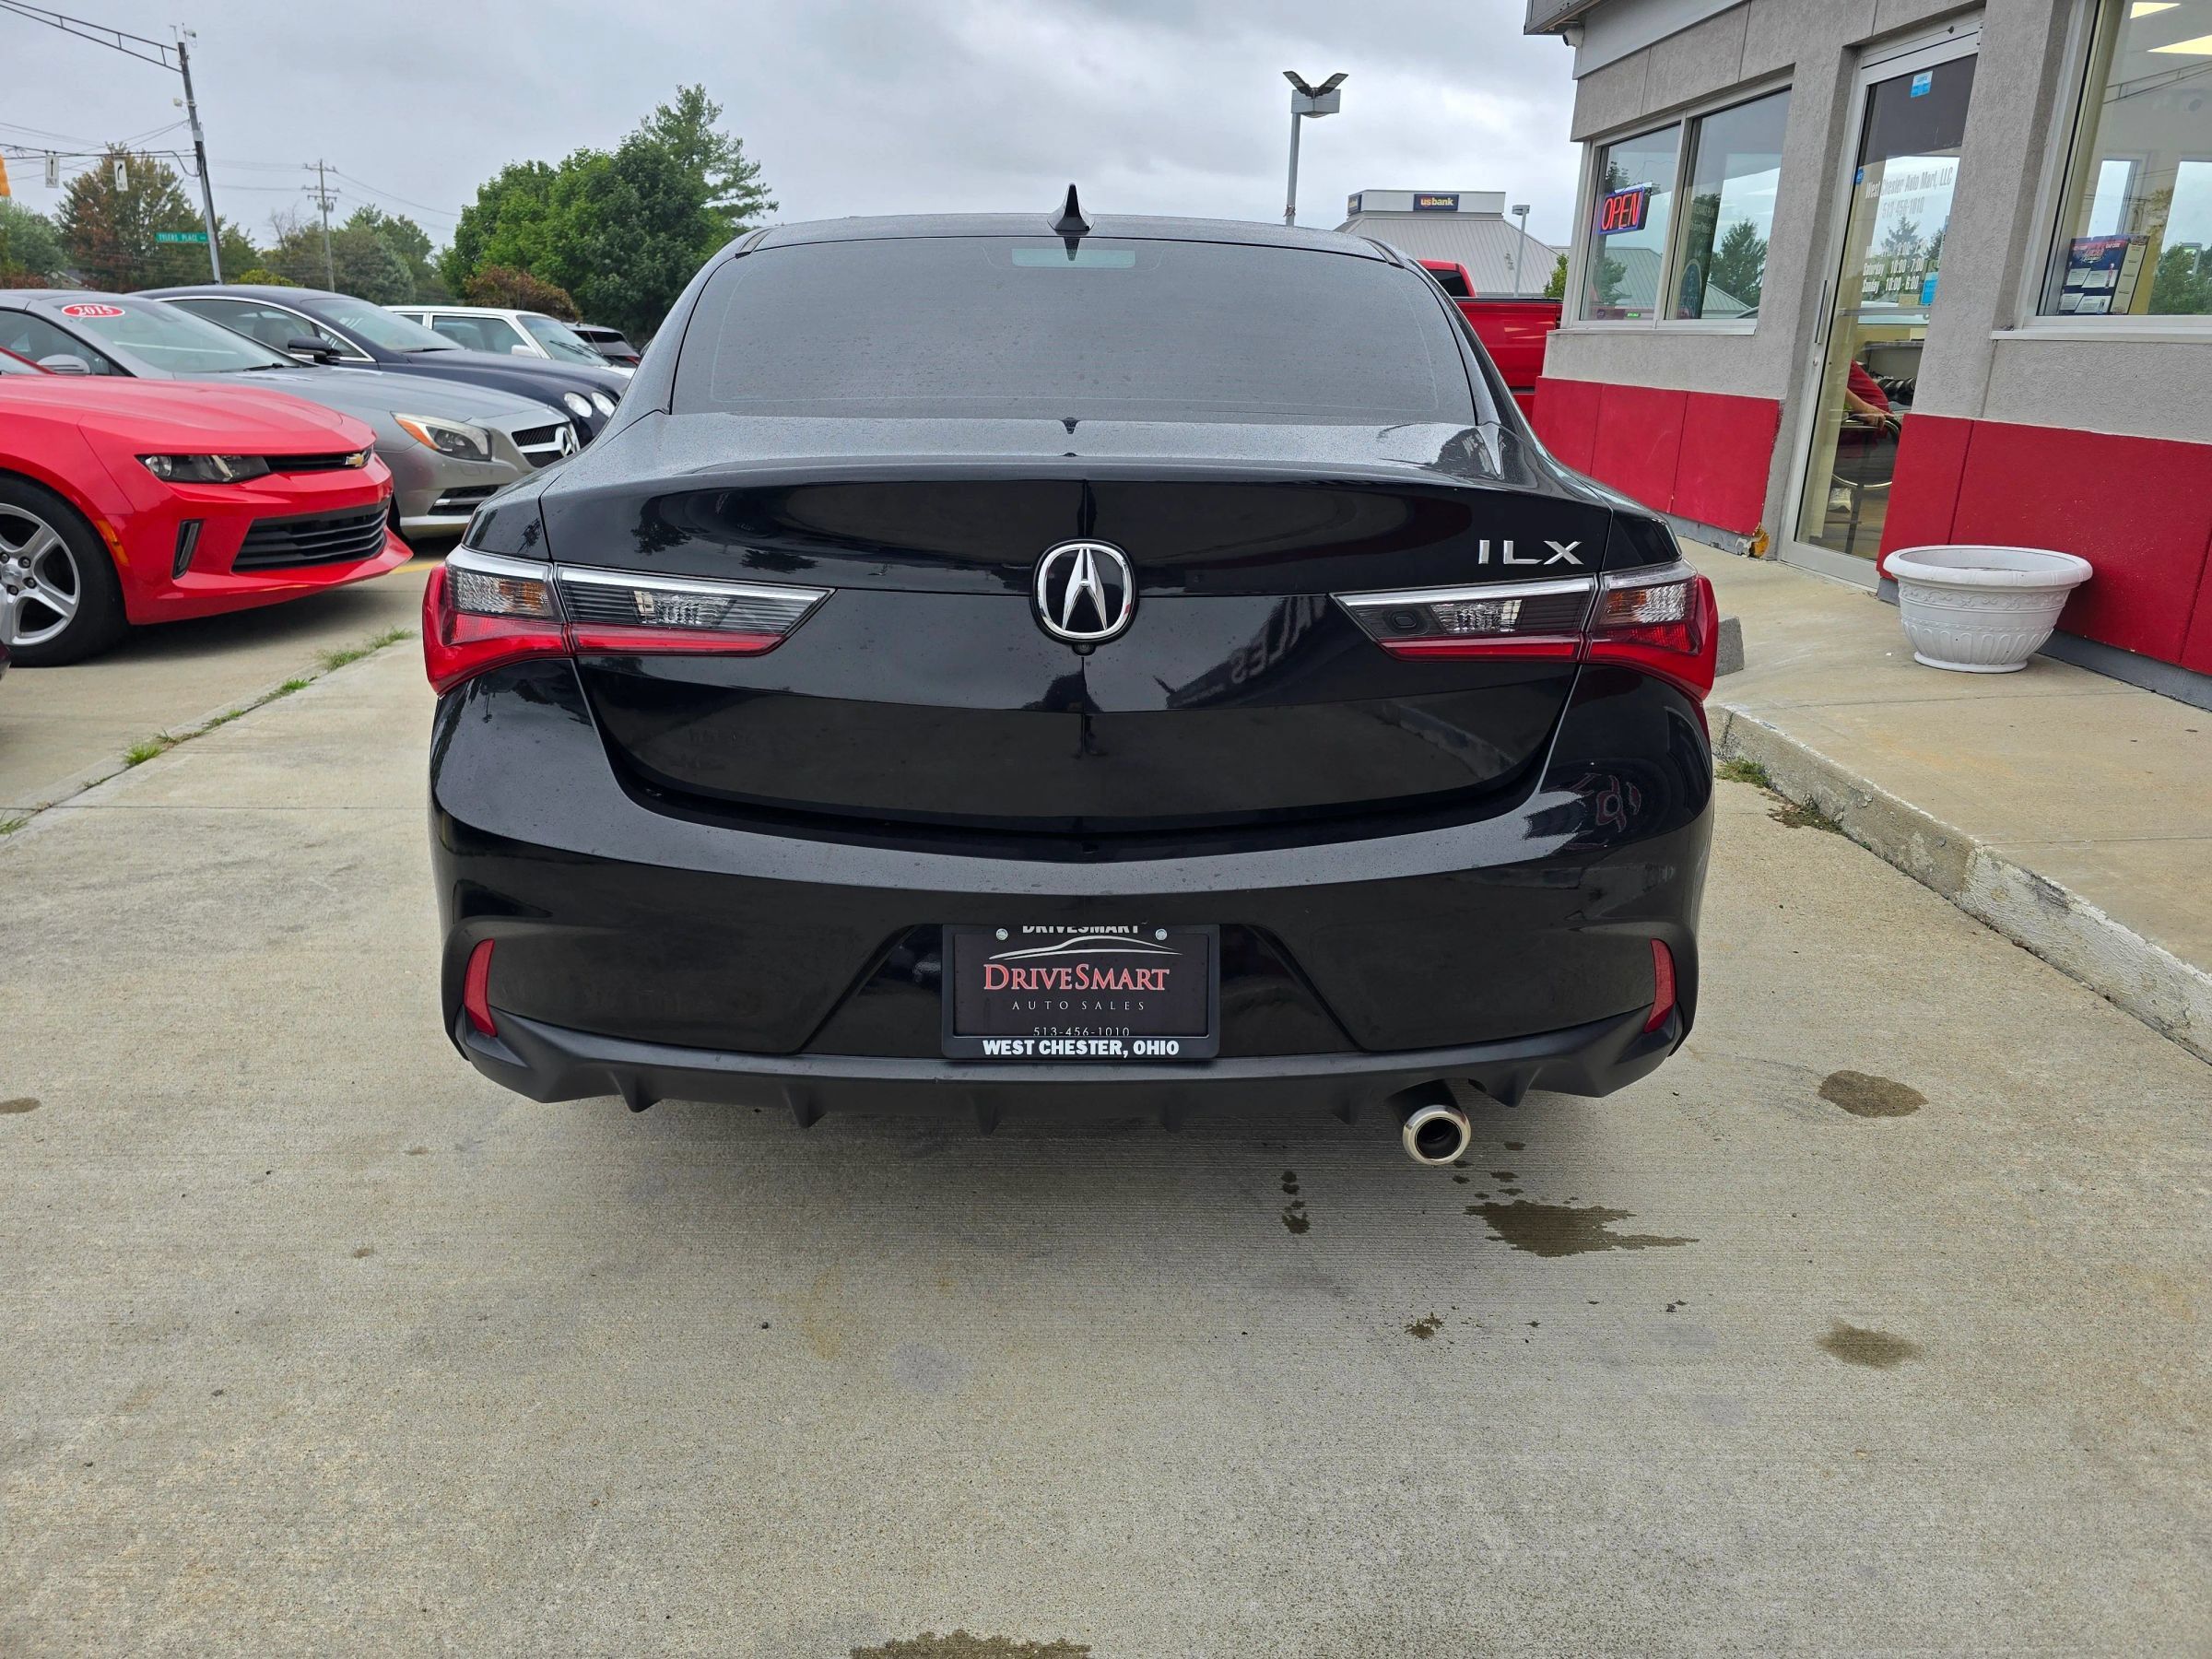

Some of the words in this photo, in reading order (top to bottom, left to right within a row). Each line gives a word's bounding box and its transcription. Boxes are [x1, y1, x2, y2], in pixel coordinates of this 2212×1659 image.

[1939, 167, 1954, 186] LLC
[1602, 192, 1642, 230] OPEN
[74, 306, 113, 316] 2015
[1477, 540, 1584, 565] ILX
[1012, 1001, 1068, 1010] AUTO
[1081, 1001, 1144, 1010] SALES
[1033, 1027, 1130, 1036] 513-456-1010
[982, 1040, 1034, 1055] WEST
[1039, 1040, 1129, 1058] CHESTER,
[1133, 1040, 1180, 1055] OHIO
